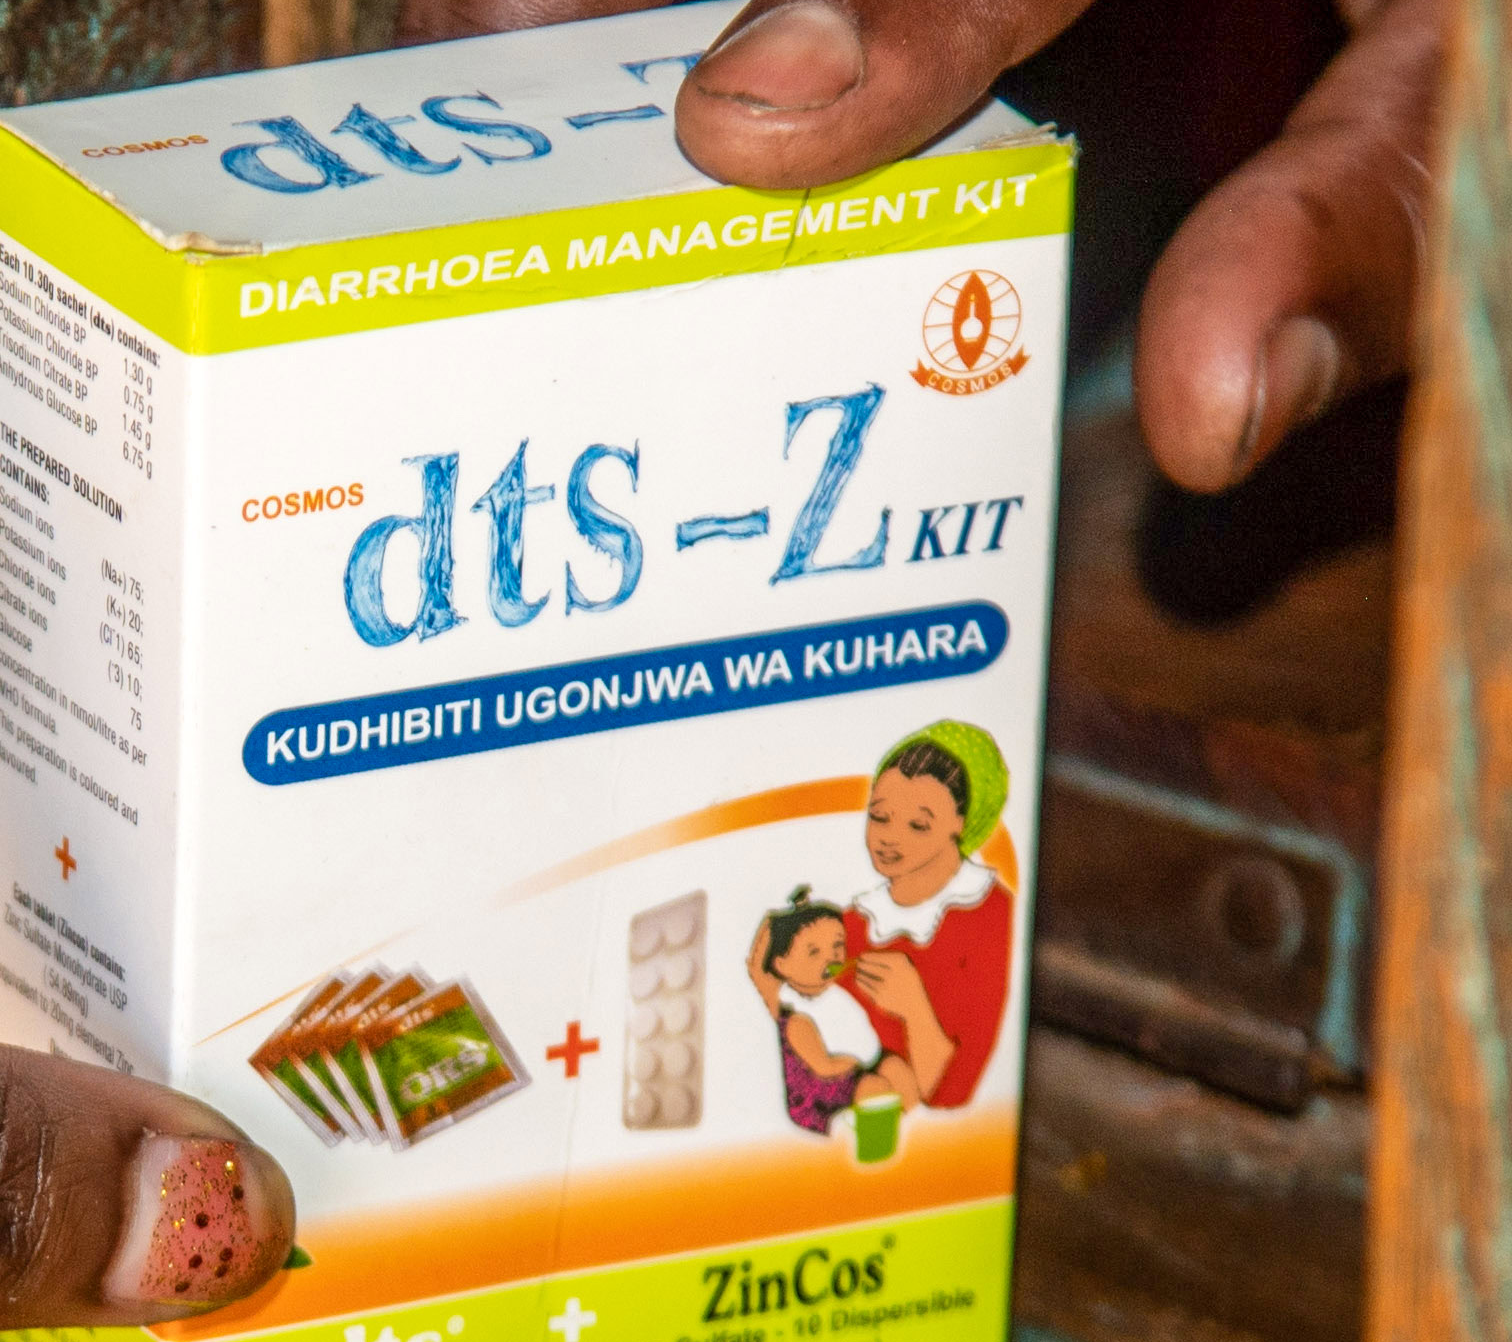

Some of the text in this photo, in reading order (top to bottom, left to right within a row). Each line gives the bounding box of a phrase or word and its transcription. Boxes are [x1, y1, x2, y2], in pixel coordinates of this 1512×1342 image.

[81, 135, 209, 158] COSMOS
[239, 174, 1036, 318] DIARRHOEA MANAGEMENT KIT
[23, 261, 54, 300] 10.30g
[57, 285, 87, 320] sachet
[90, 305, 115, 340] (dts)
[117, 328, 160, 369] contains:
[34, 296, 71, 336] Chloride
[73, 323, 86, 345] BP
[124, 358, 144, 385] 1.30
[43, 360, 73, 394] Citrate
[75, 382, 88, 402] BP
[122, 413, 142, 441] 1.45
[46, 328, 82, 372] Chloride
[85, 359, 98, 382] BP
[124, 385, 144, 414] 0.75
[927, 362, 1012, 394] COSMOS
[46, 389, 82, 428] Glucose
[85, 417, 97, 437] BP
[122, 441, 143, 470] 6.75
[0, 421, 123, 523] THE PREPARED SOLUTION
[0, 454, 50, 505] CONTAINS:
[241, 482, 365, 523] COSMOS
[0, 485, 33, 525] Sodium
[35, 514, 55, 541] ions
[101, 558, 126, 595] (Na+)
[906, 495, 1023, 563] KIT
[28, 605, 48, 632] ions
[37, 580, 56, 606] ions
[47, 552, 66, 581] ions
[106, 594, 126, 627] (K+)
[59, 688, 68, 709] in
[70, 701, 117, 746] mmol/litre
[118, 735, 129, 755] as
[131, 746, 148, 767] per
[130, 707, 142, 731] 75
[265, 618, 987, 765] KUDHIBITI UGONJWA WA KUHARA
[17, 726, 67, 774] preparation
[69, 760, 78, 781] is
[79, 772, 119, 812] coloured
[121, 802, 138, 826] and
[108, 983, 128, 1012] USP
[831, 1286, 975, 1333] Dispersible
